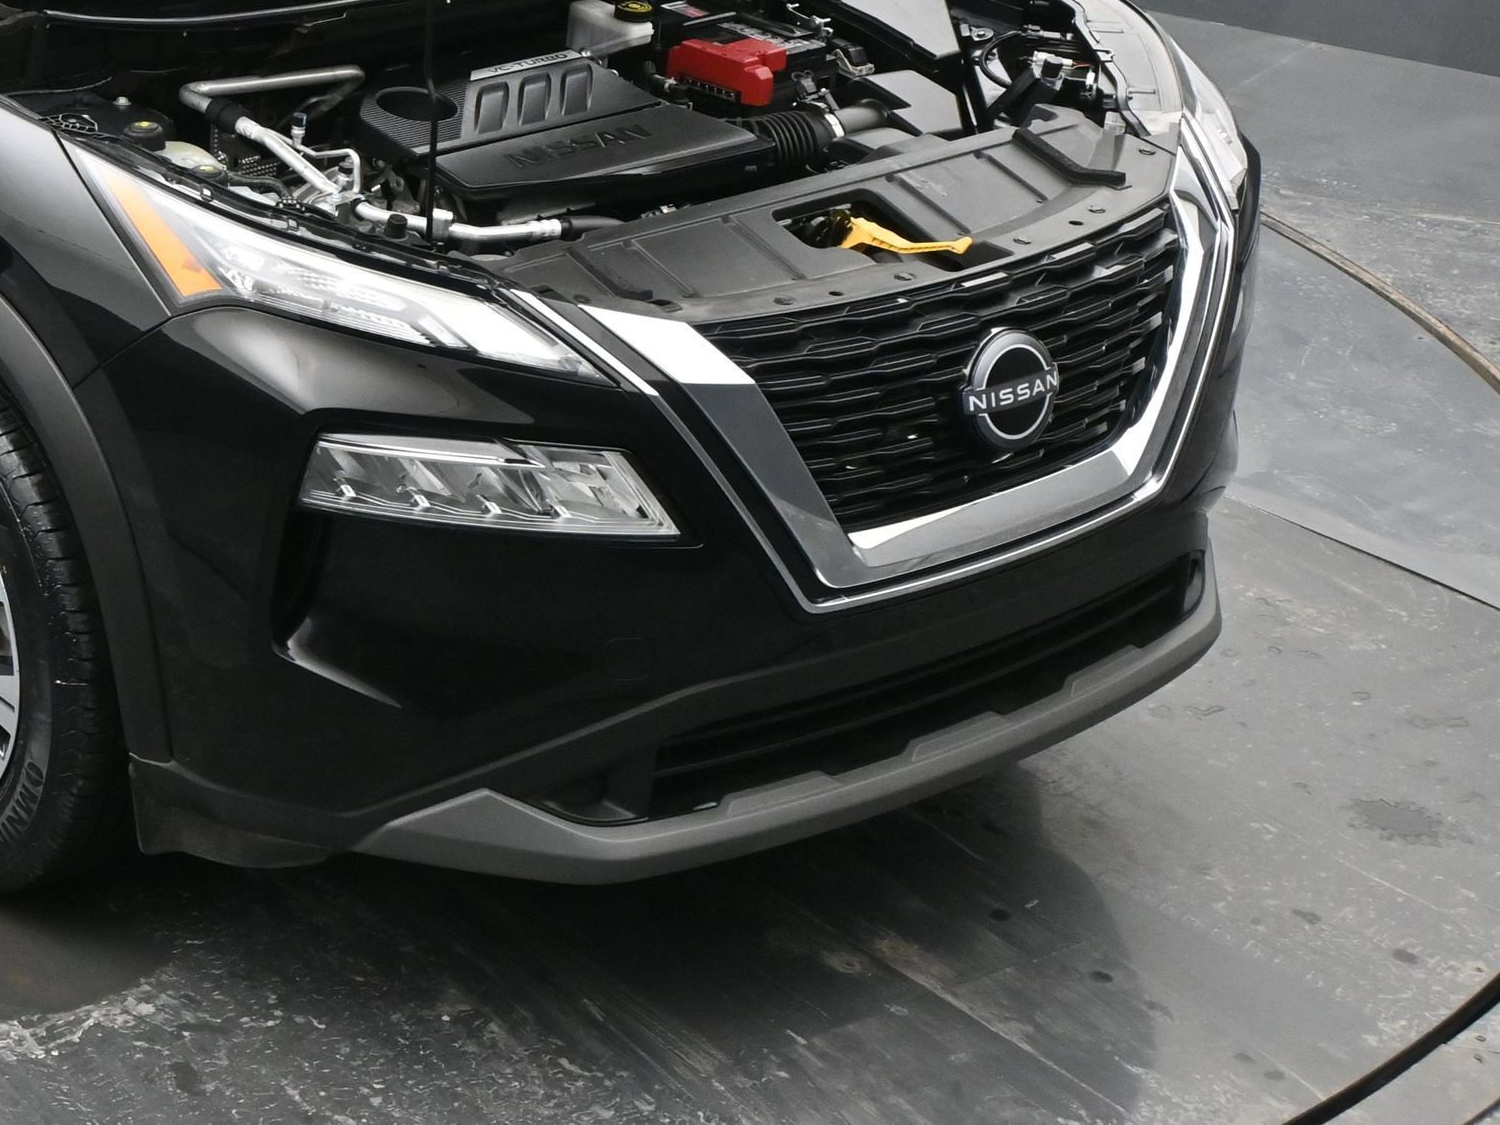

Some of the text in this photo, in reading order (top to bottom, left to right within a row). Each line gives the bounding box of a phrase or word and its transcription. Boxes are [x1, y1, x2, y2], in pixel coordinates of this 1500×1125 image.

[487, 53, 568, 73] VC-TURBO
[504, 124, 652, 168] NISSAN
[968, 370, 1058, 412] NISSAN
